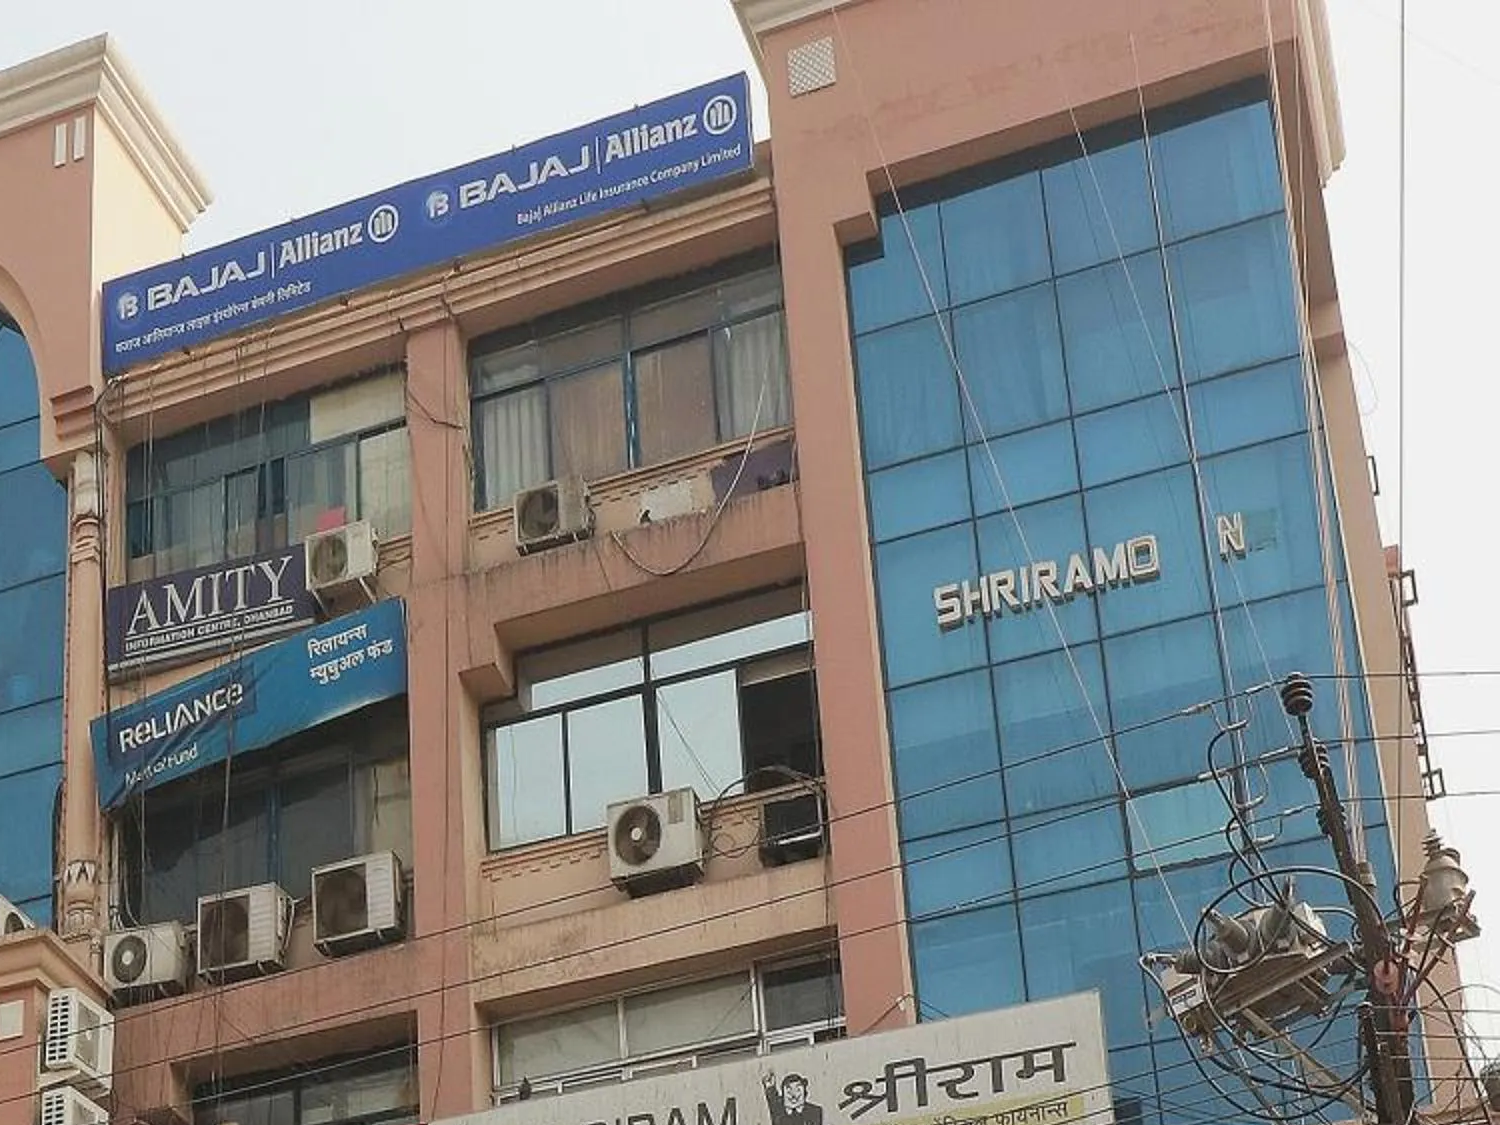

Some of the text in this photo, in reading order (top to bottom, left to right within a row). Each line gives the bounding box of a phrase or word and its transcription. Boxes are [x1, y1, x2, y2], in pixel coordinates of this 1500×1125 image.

[459, 144, 590, 209] BAJAJ
[605, 112, 698, 164] Allianz
[580, 190, 598, 207] Life
[599, 175, 649, 200] Insurance
[650, 160, 699, 184] Company
[700, 143, 741, 167] Limited
[147, 251, 266, 311] BAJAJ
[279, 222, 364, 268] Allianz
[125, 627, 195, 651] INFORMATION
[243, 605, 294, 627] DHANBAD
[127, 555, 294, 635] AMITY
[167, 743, 198, 769] Fund
[838, 1042, 1077, 1120] श्रीराम
